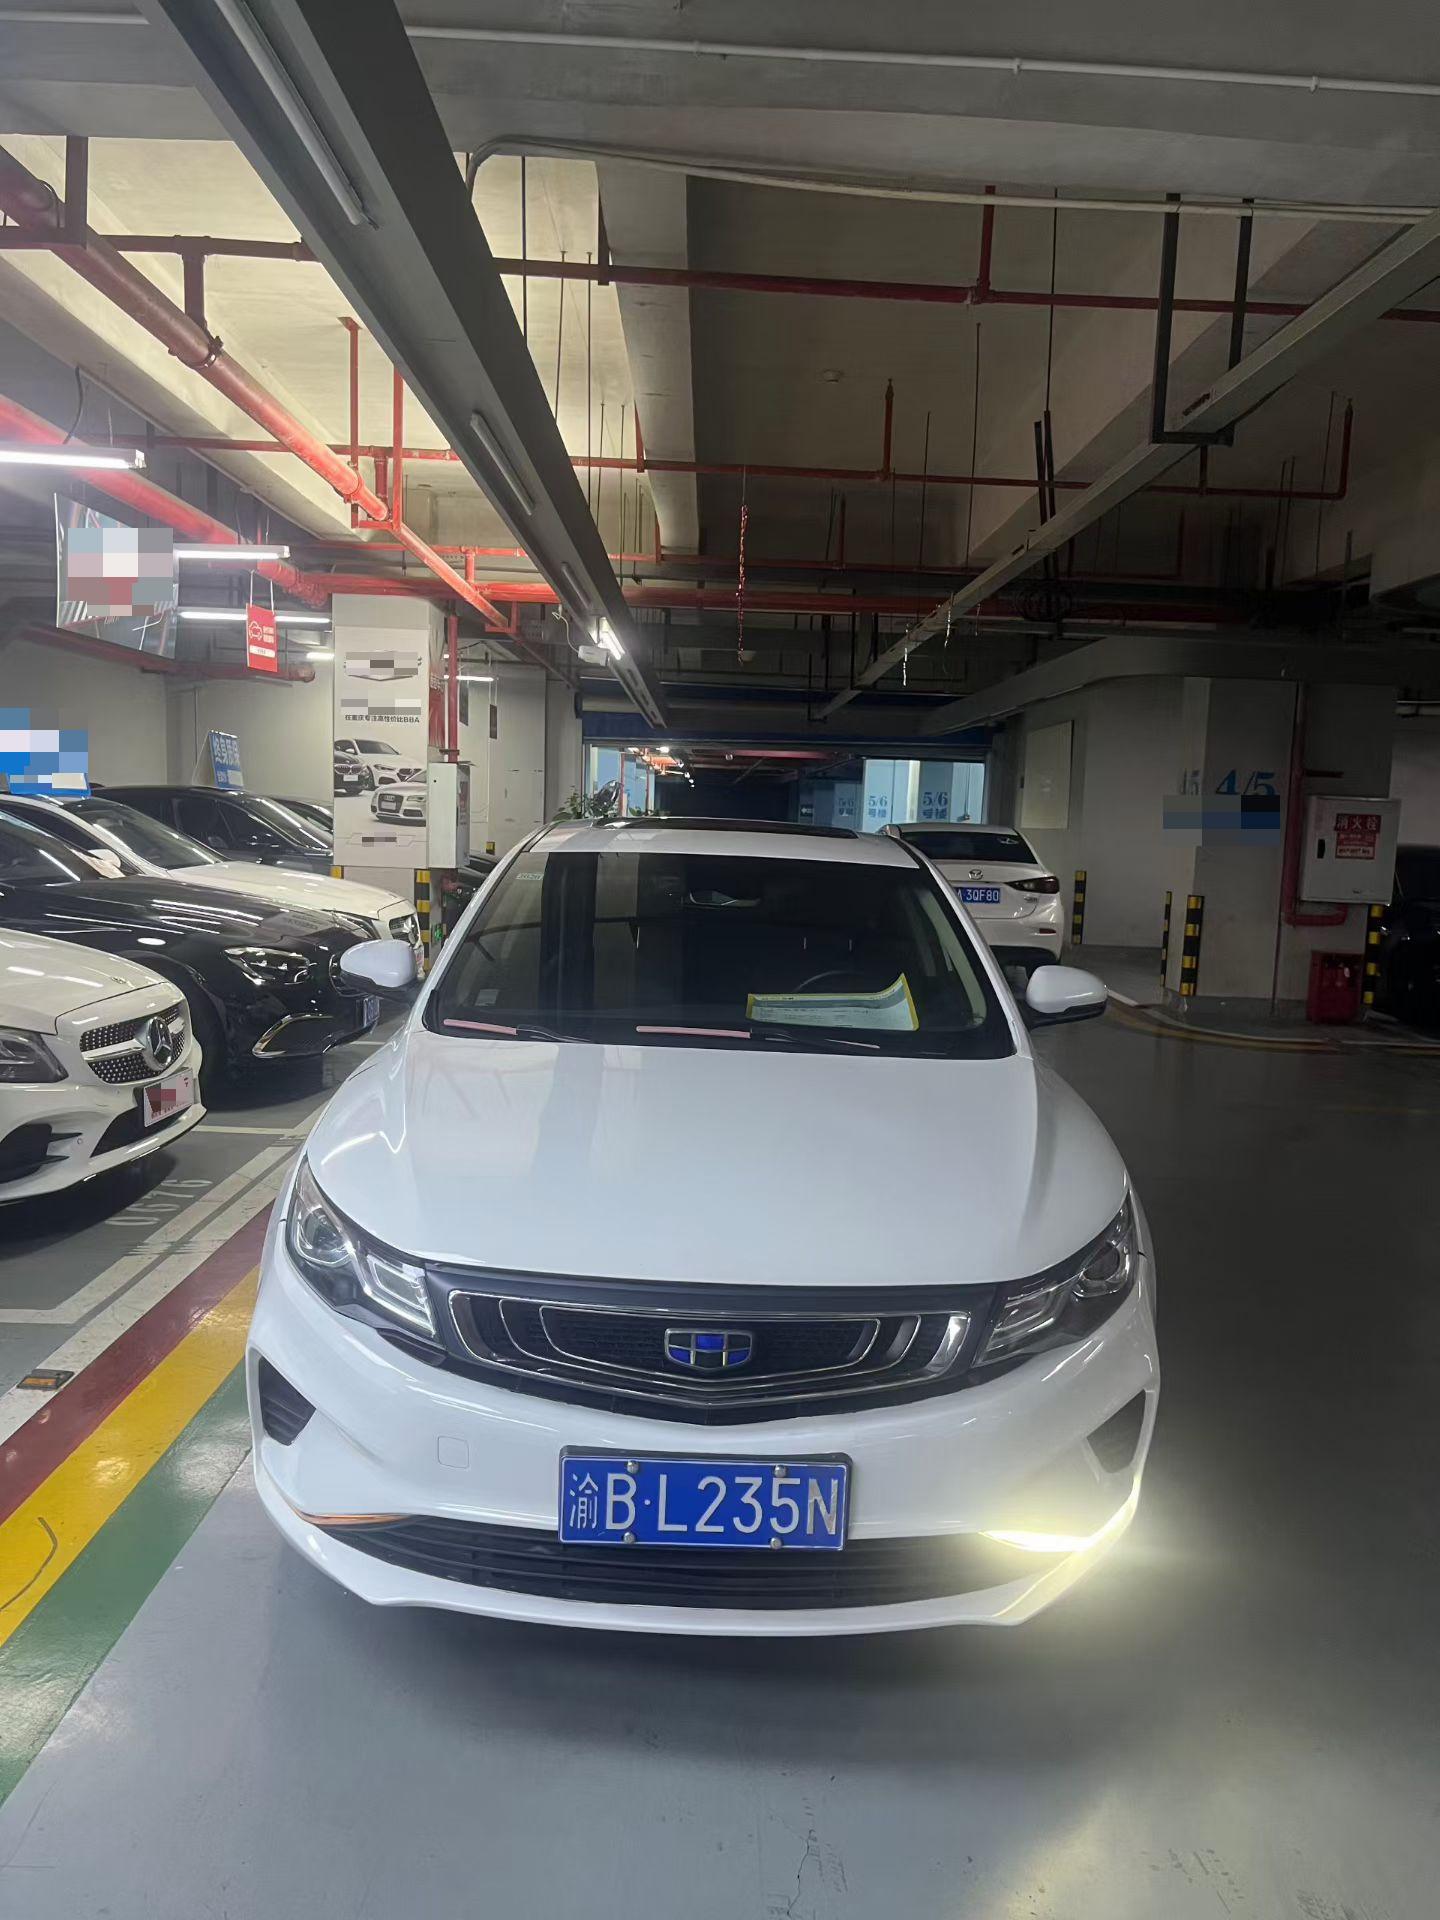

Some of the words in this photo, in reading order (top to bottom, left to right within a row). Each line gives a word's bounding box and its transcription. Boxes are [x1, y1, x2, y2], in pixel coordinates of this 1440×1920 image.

[868, 795, 888, 807] 5/6
[922, 792, 948, 806] 5/6
[1336, 815, 1377, 831] 消火栓
